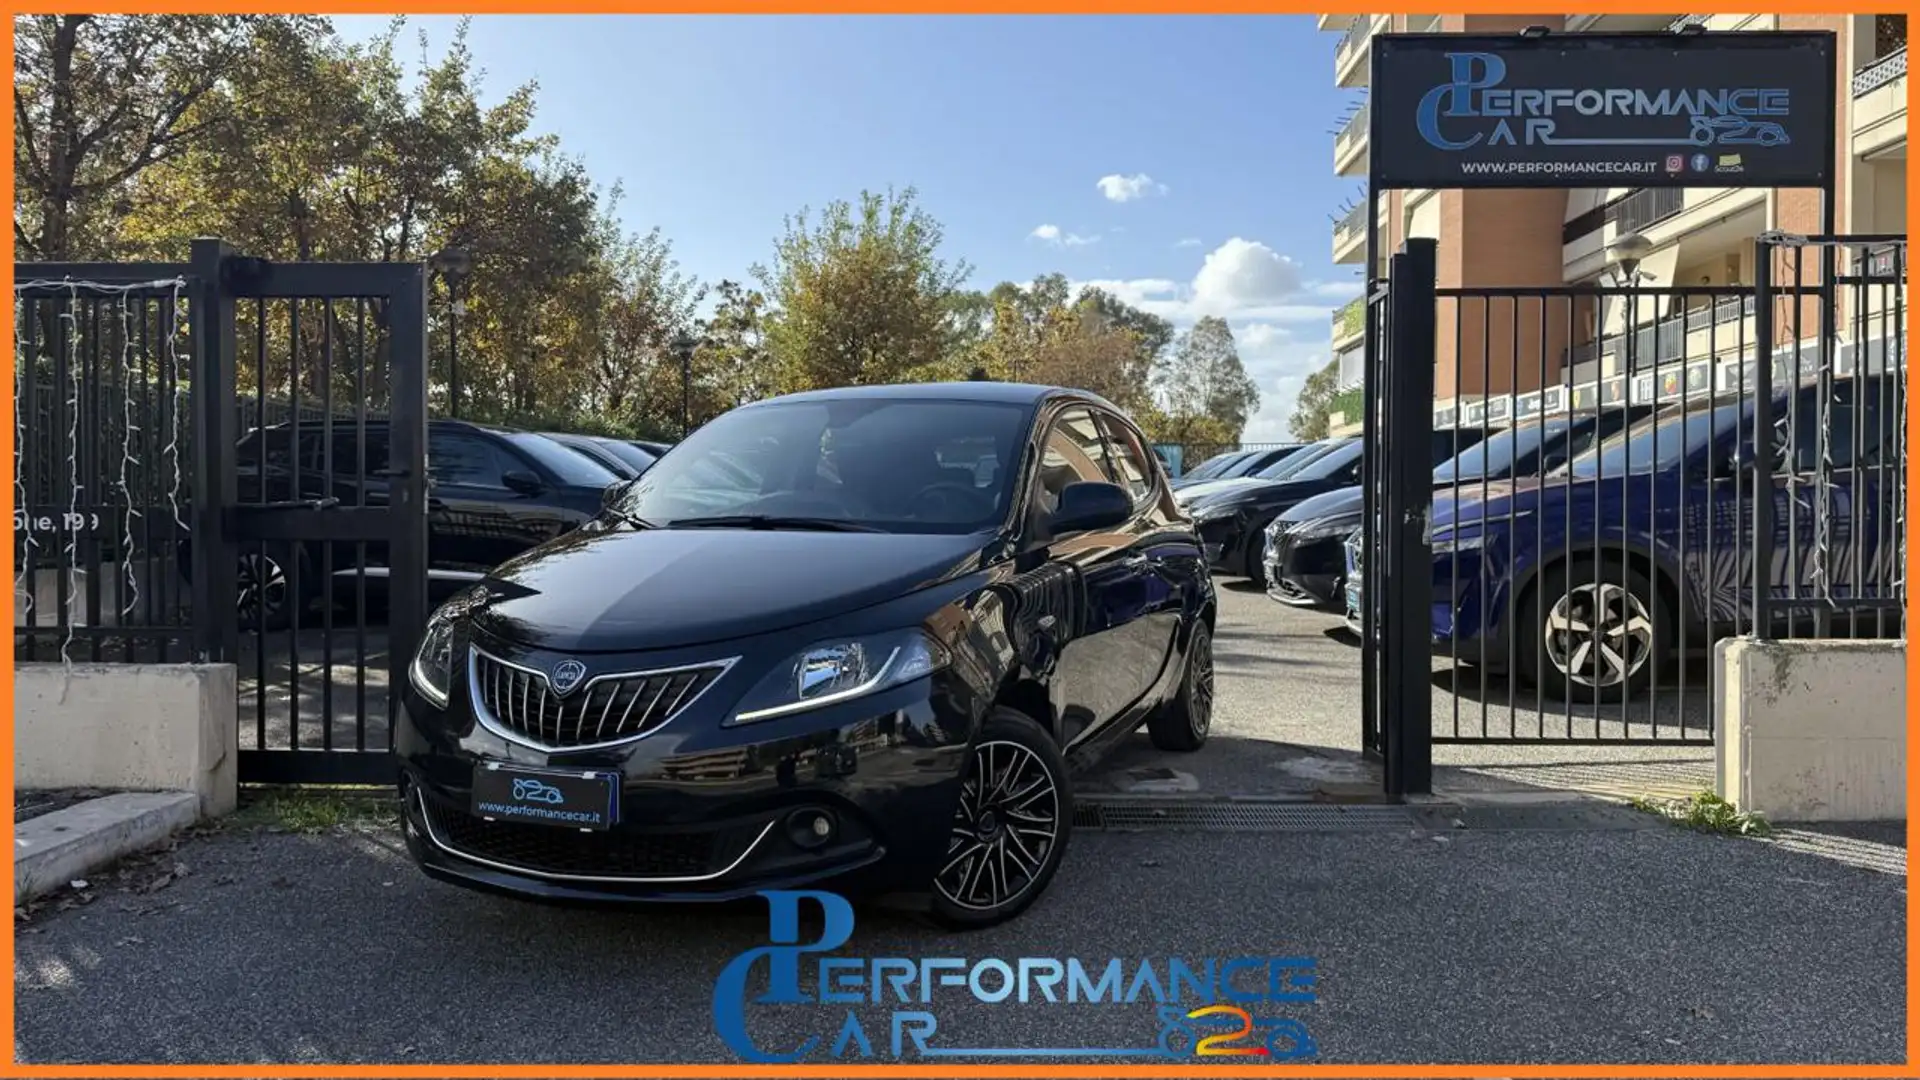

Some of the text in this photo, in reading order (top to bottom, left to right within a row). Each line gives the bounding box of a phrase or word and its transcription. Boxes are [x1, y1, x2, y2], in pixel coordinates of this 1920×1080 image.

[1443, 52, 1790, 116] PERFORMANCE
[1416, 82, 1555, 150] CAR
[1461, 161, 1657, 174] WWW.PERFORMANCECAR.IT
[478, 801, 601, 823] www.performancecar.it
